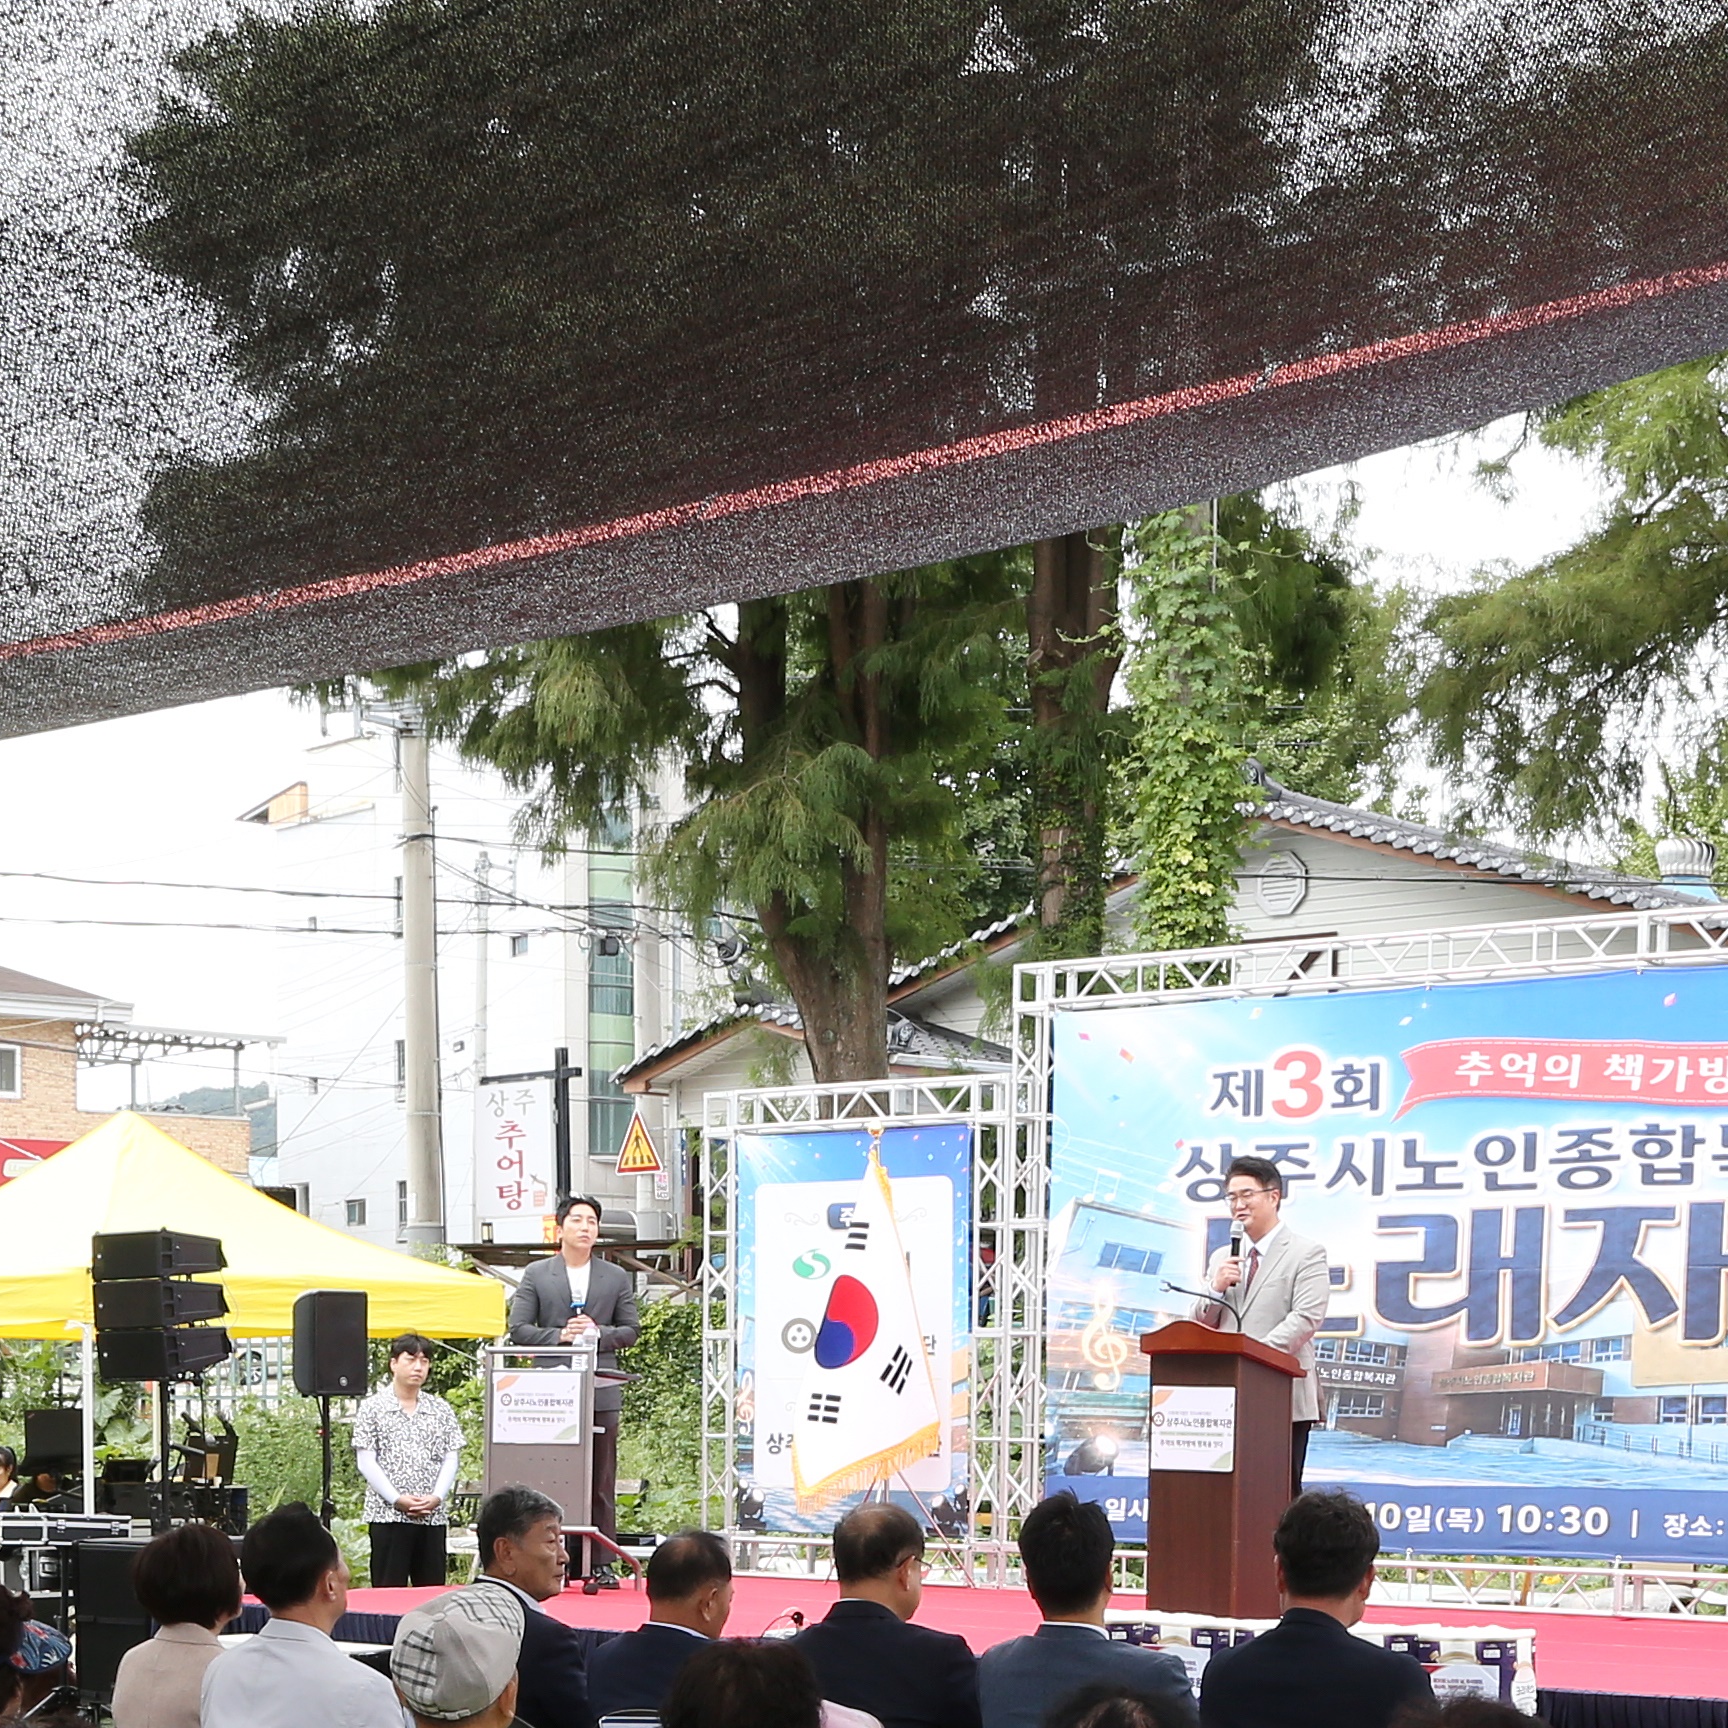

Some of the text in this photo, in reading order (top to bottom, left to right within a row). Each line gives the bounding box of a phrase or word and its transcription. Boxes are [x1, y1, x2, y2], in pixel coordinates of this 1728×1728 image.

[1209, 1050, 1382, 1119] 제3회
[1454, 1052, 1582, 1089] 추억의
[485, 1088, 536, 1118] 상주
[494, 1120, 529, 1211] 추어탕
[1315, 1366, 1397, 1386] 노인종합복지관
[1497, 1503, 1610, 1537] 10:30
[1663, 1511, 1726, 1540] 장소:
